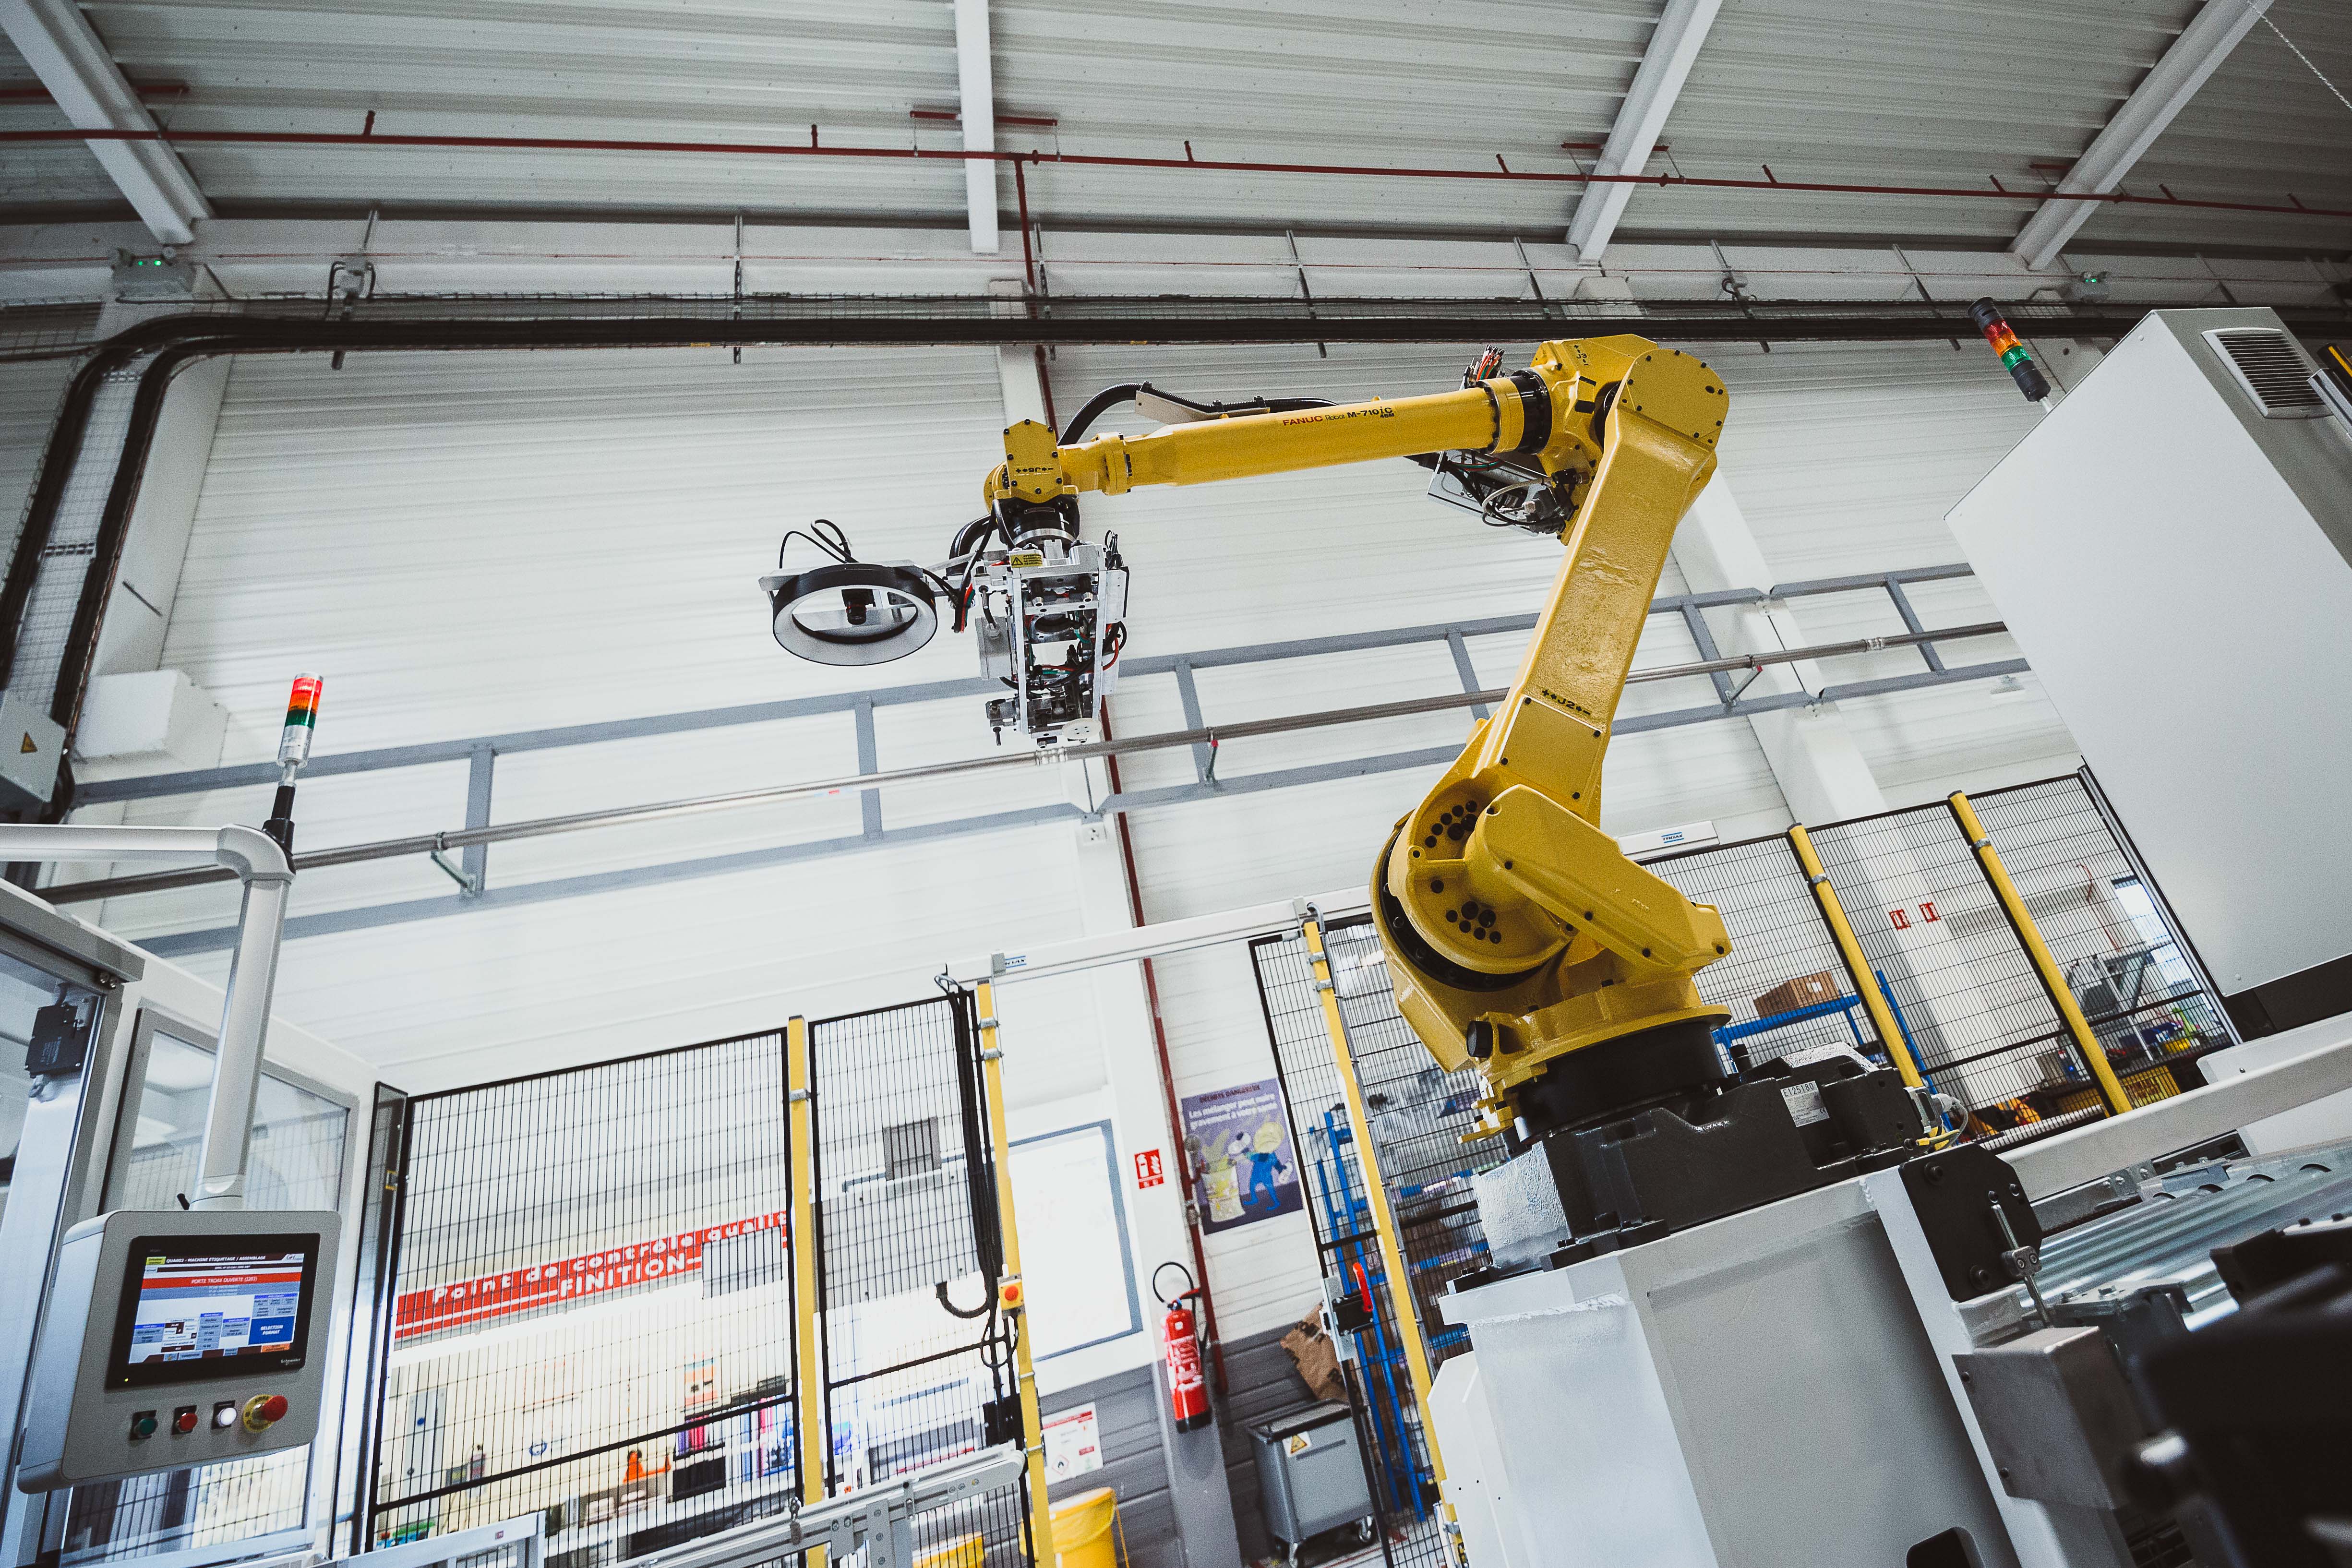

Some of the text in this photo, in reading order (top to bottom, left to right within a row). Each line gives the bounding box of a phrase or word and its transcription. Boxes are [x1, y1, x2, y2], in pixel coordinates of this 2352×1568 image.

[1283, 416, 1323, 426] FANUC
[1783, 1082, 1814, 1097] E125180
[433, 1275, 512, 1304] Point
[526, 1266, 558, 1282] de
[707, 1212, 787, 1241] qualit
[561, 1252, 685, 1297] FINITION
